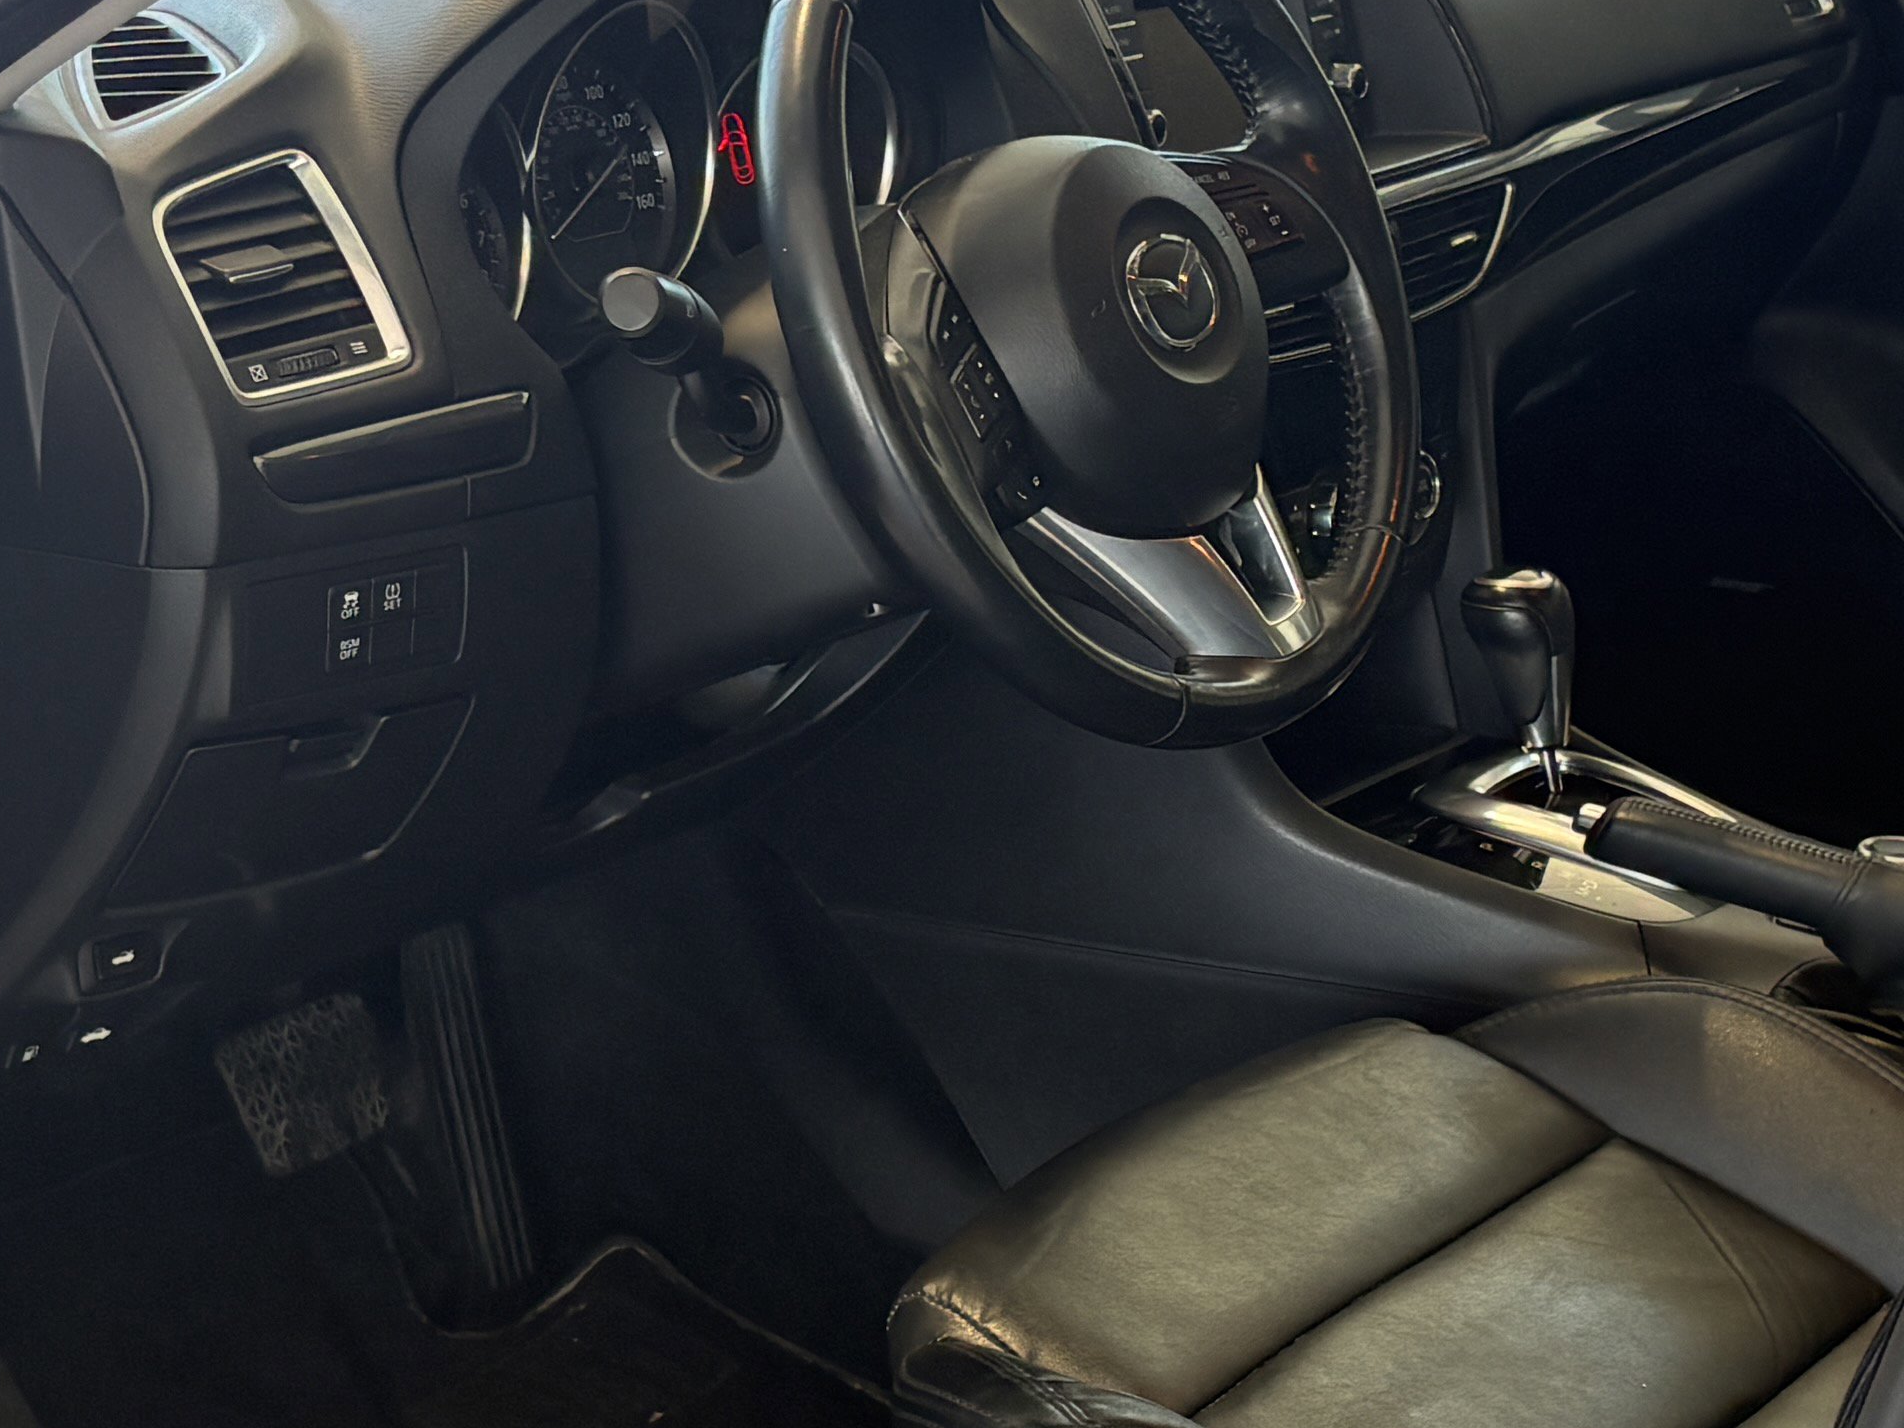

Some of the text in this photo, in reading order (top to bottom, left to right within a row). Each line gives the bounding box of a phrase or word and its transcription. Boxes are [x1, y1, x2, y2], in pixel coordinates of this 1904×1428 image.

[584, 84, 604, 100] 100
[612, 112, 631, 129] 120
[630, 150, 650, 167] 140
[636, 193, 655, 211] 160
[478, 230, 486, 248] 7
[384, 598, 403, 611] SET
[341, 607, 360, 619] OFF
[339, 648, 358, 660] OFF
